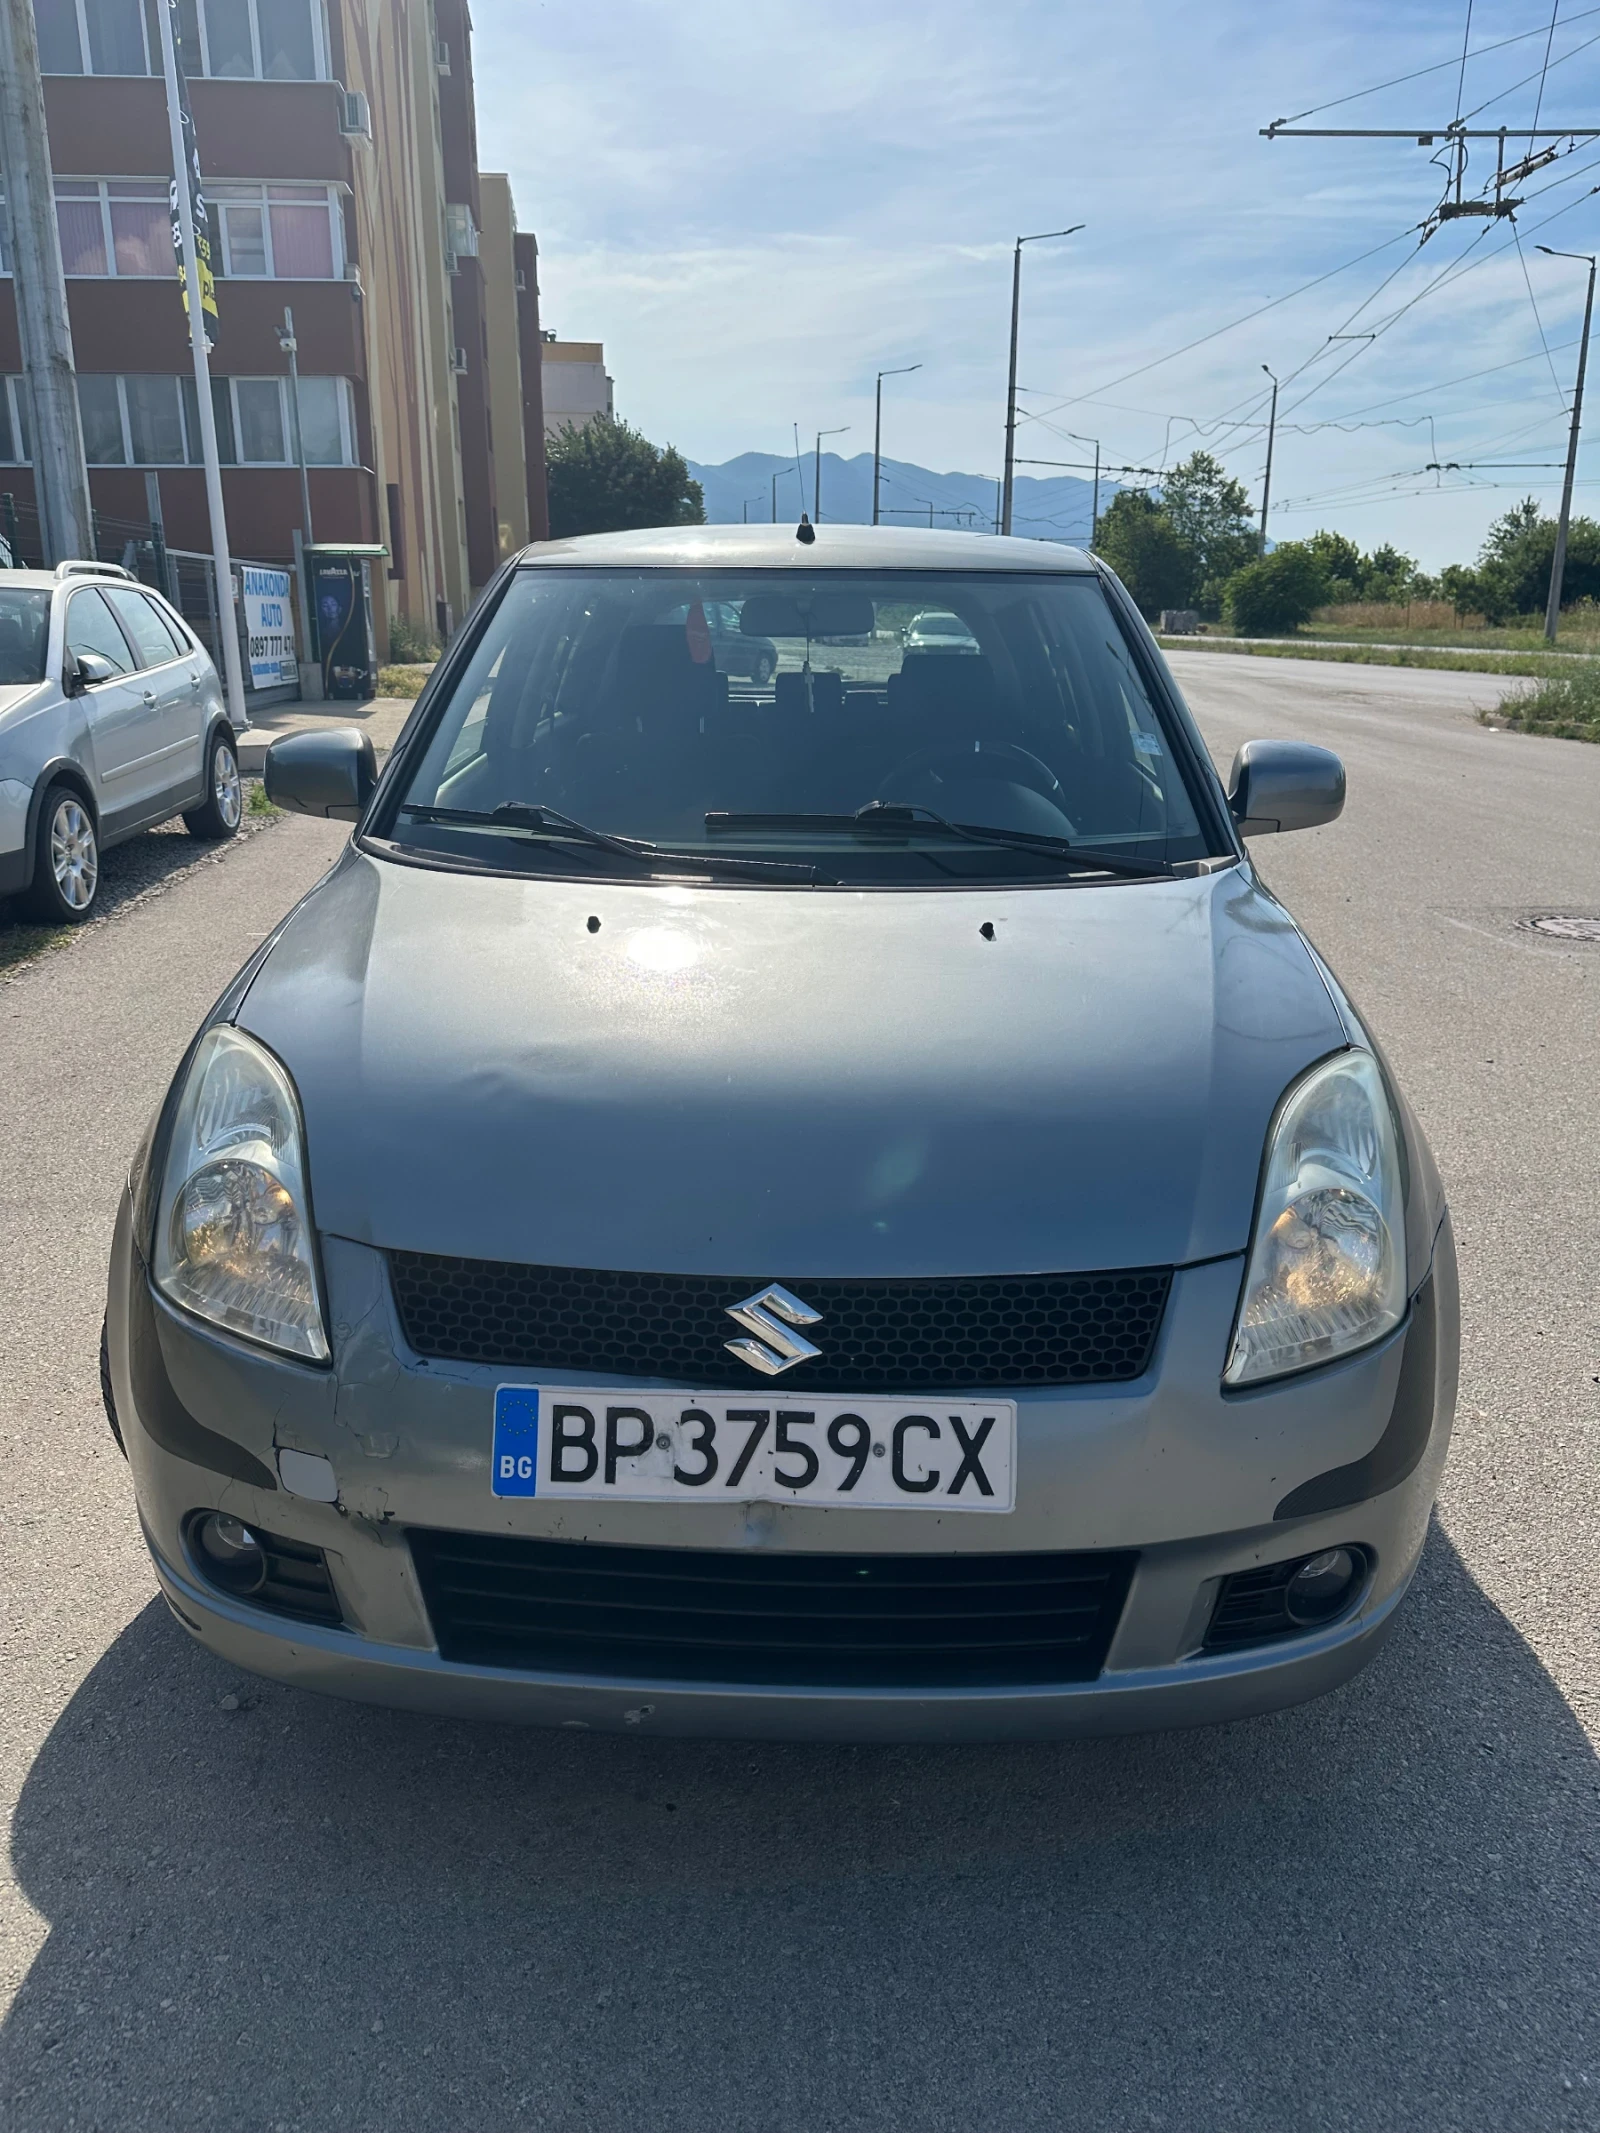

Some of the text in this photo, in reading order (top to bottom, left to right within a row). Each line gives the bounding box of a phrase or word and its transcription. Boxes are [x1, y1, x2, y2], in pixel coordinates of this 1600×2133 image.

[245, 571, 289, 597] ANAKONDA
[261, 602, 283, 628] AUTO
[250, 636, 268, 657] 0897
[269, 636, 282, 656] 777
[550, 1404, 996, 1497] BP 3759 CX
[499, 1454, 532, 1479] BG
